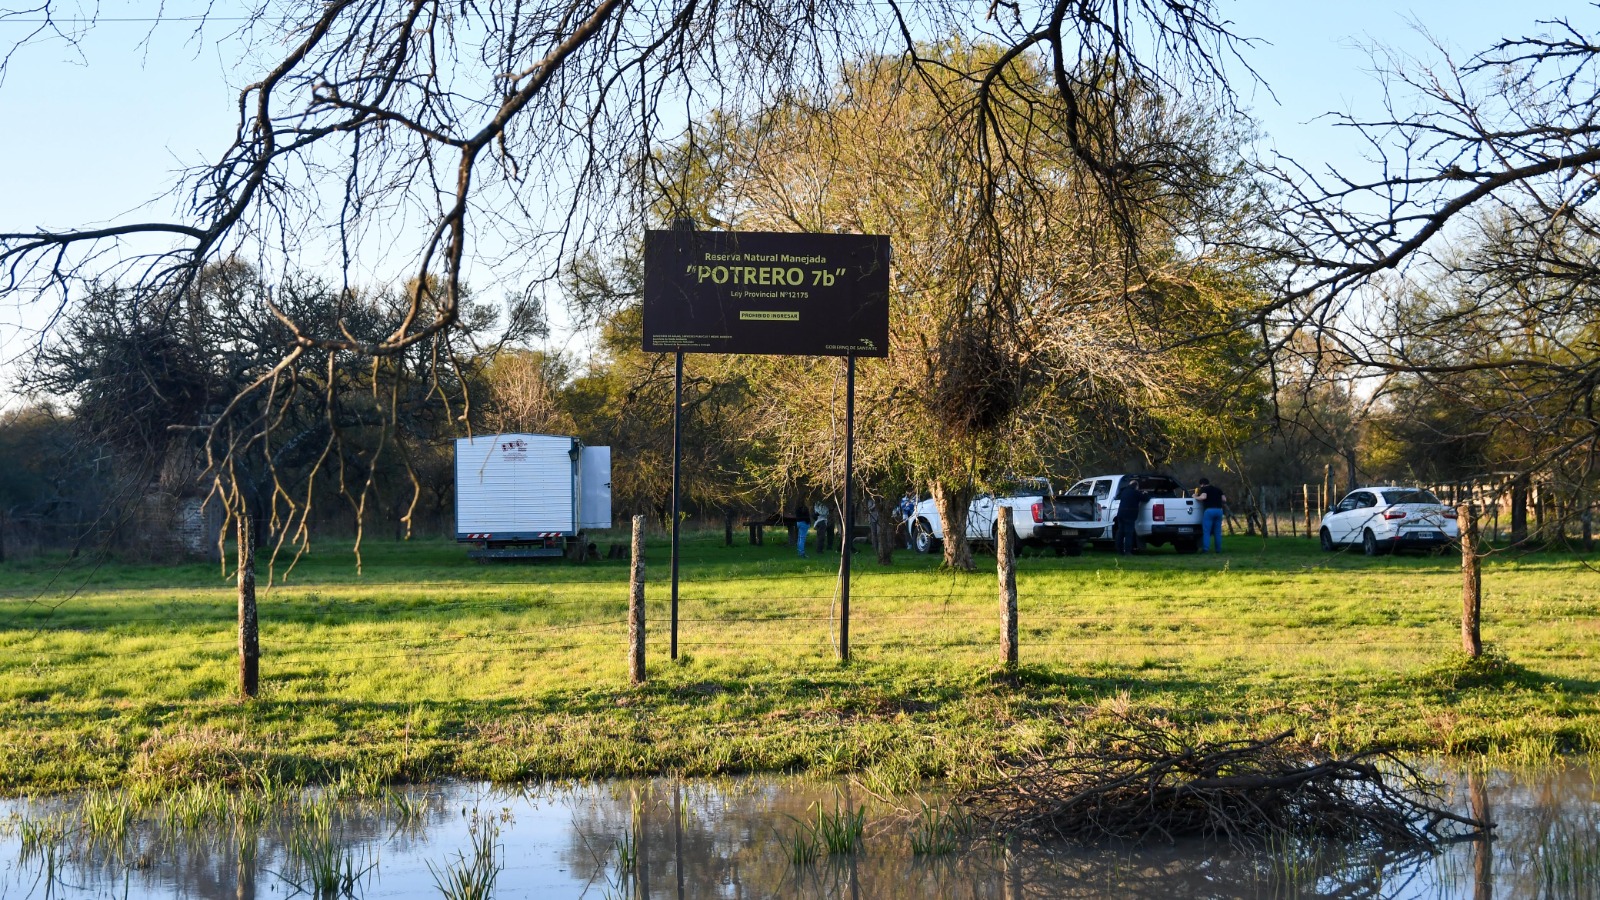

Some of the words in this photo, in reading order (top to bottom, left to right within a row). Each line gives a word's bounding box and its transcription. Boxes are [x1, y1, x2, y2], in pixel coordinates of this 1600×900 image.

[705, 252, 741, 262] Reserva
[744, 253, 778, 263] Natural
[781, 254, 827, 265] Manejada
[730, 291, 742, 299] Ley
